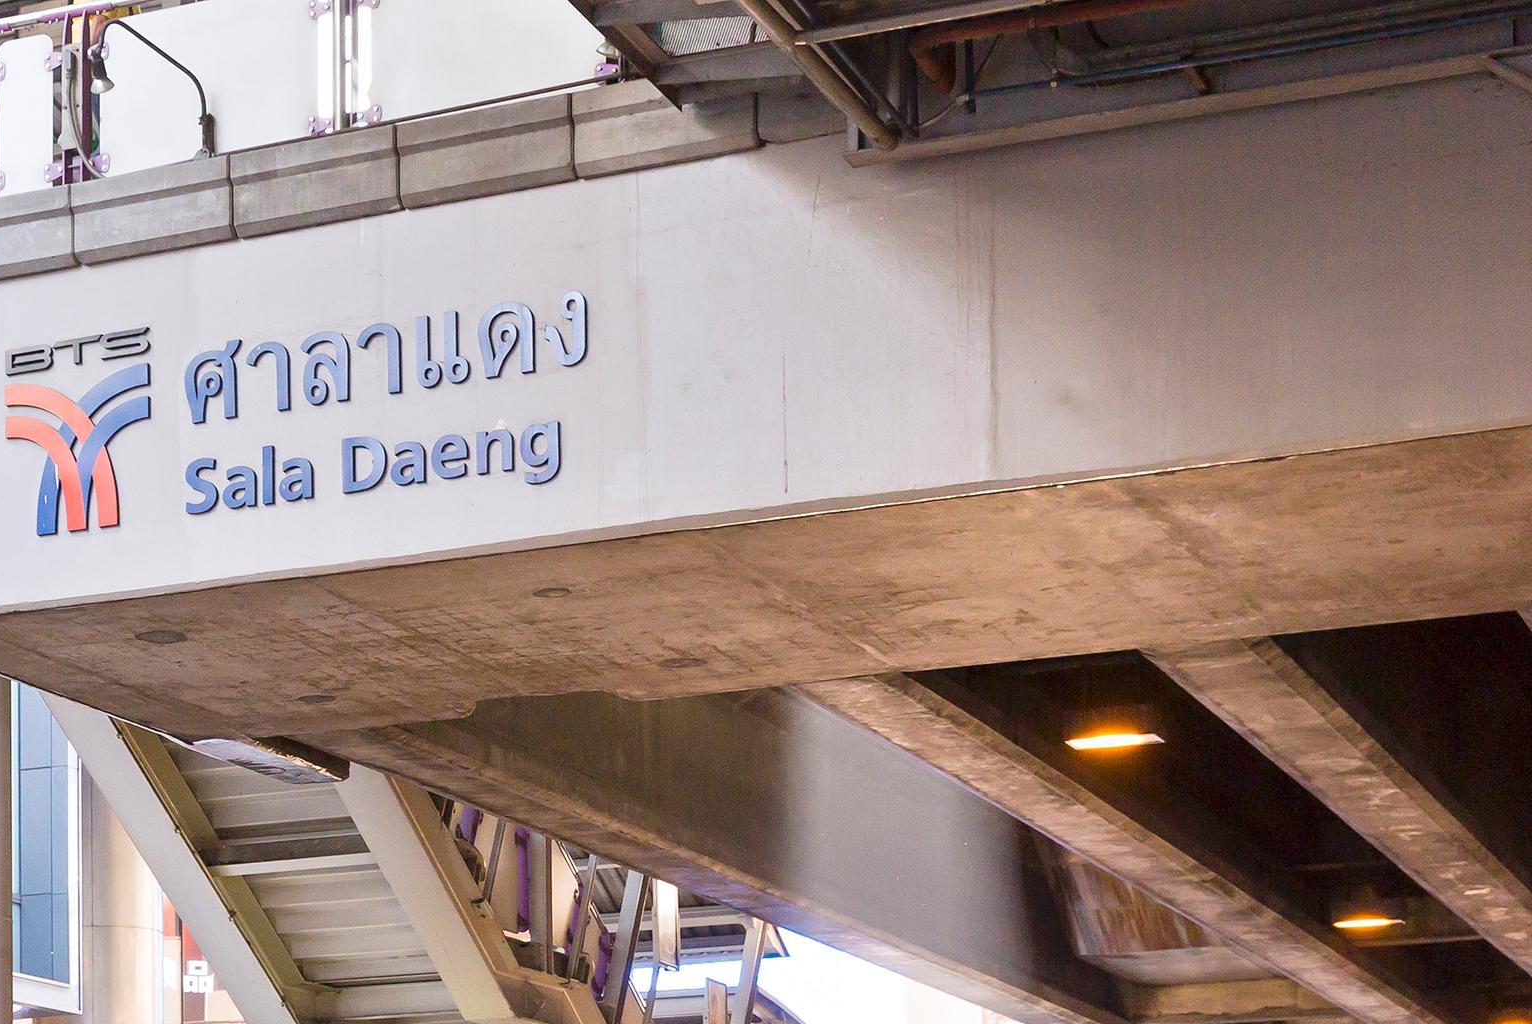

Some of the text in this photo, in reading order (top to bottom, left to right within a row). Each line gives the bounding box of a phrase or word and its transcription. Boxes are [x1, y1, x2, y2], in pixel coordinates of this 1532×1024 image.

[5, 326, 151, 376] BTS
[184, 290, 589, 423] ศาลาแดง
[185, 420, 562, 515] Sala Daeng
